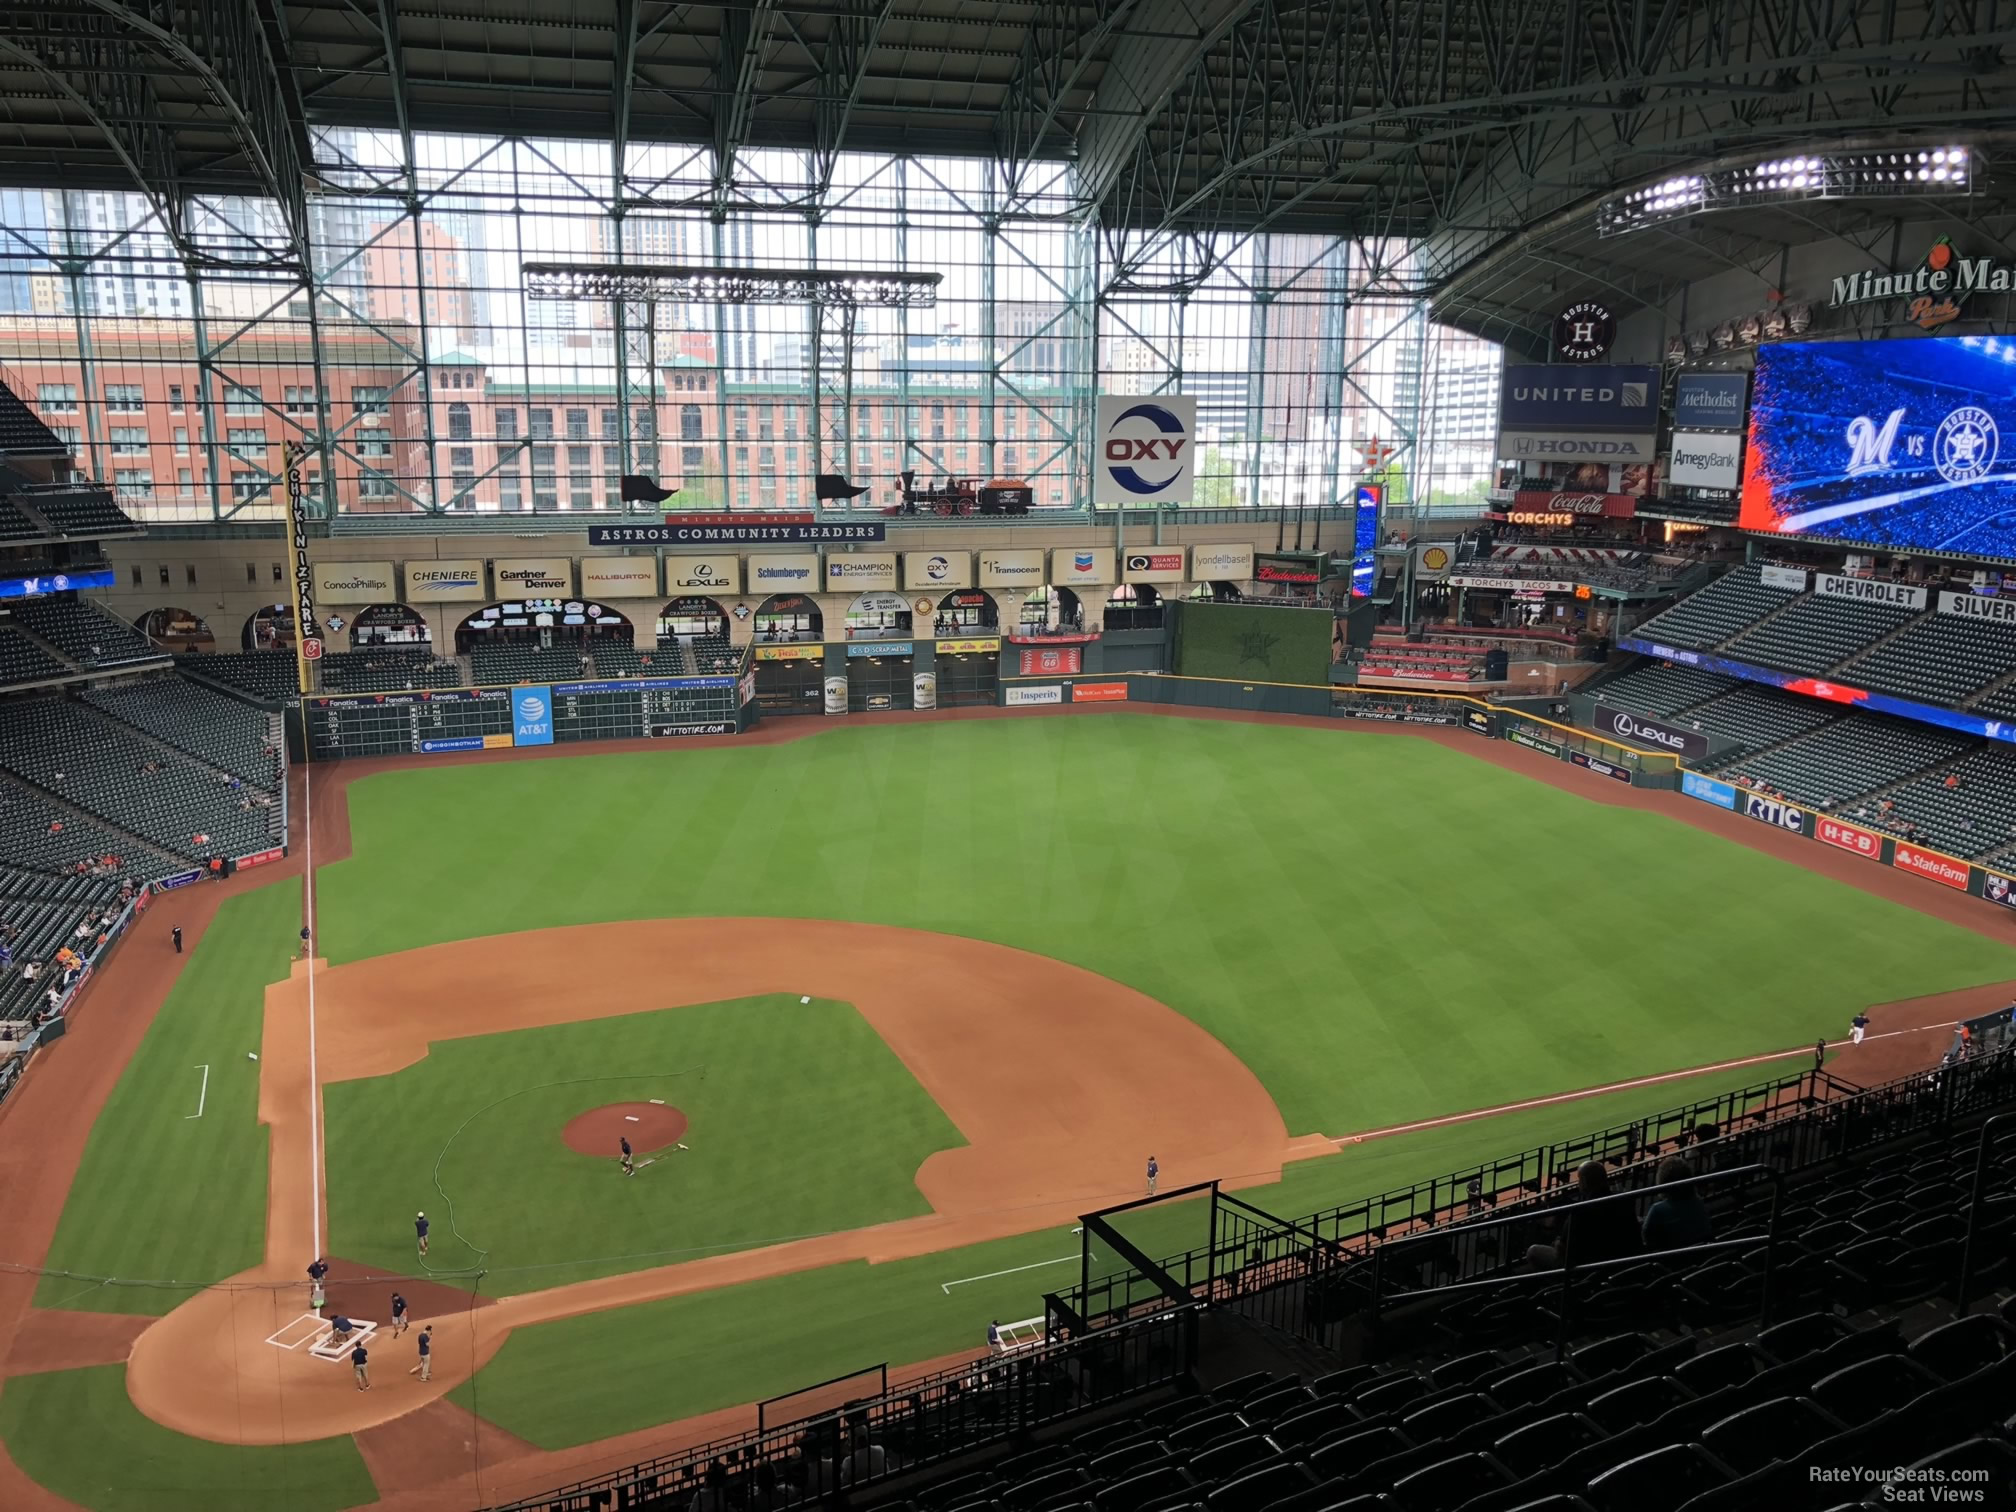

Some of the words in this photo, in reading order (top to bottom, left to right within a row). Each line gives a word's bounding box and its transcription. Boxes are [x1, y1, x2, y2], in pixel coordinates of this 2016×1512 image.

[1829, 266, 1948, 307] Minute
[1561, 303, 1609, 321] HOUSTON
[1909, 296, 1960, 322] Park
[1572, 322, 1594, 342] H
[1561, 344, 1604, 360] ASTROS
[1513, 387, 1615, 402] UNITED
[1681, 390, 1737, 408] Methodist
[1943, 410, 1994, 433] HOUSTON
[1105, 438, 1187, 461] OXY
[1537, 440, 1640, 455] HONDA
[1952, 433, 1976, 460] H
[1673, 449, 1734, 470] AmegyBank
[1940, 463, 1986, 482] ASTROS
[1548, 493, 1605, 514] Coca-Cola
[1506, 511, 1573, 526] TORCHYS
[678, 527, 791, 540] COMMUNITY
[799, 526, 875, 538] LEADERS
[843, 563, 893, 572] CHAMPION
[927, 563, 949, 571] OXY
[994, 566, 1040, 574] Transocean
[412, 570, 478, 581] CHENIERE
[500, 570, 546, 579] Gardner
[587, 573, 651, 581] HALLIBURTON
[757, 567, 810, 580] Schlumberger
[1256, 566, 1320, 582] Budweiser
[323, 579, 387, 590] ConocoPhillips
[525, 579, 566, 588] Denver
[677, 578, 730, 587] LEXUS
[1470, 578, 1515, 588] TORCHYS
[1520, 580, 1552, 589] TACOS
[1824, 576, 1917, 605] CHEVROLET
[1043, 658, 1056, 667] 66
[1391, 668, 1435, 679] Budweiser
[385, 695, 414, 704] Fanatics
[431, 693, 459, 701] Fanatics
[479, 690, 507, 698] Fanatics
[1020, 690, 1058, 700] Insperity
[329, 699, 358, 707] Fanatics
[1355, 711, 1397, 720] NITTOTIRE.COM
[1403, 716, 1447, 725] NITTOTIRE.COM
[518, 723, 548, 735] AT&T
[662, 724, 725, 736] NITTOTIRE.COM
[1518, 734, 1535, 747] National
[1633, 724, 1685, 750] LEXUS
[432, 740, 481, 749] HIGGINBOTHAM
[1626, 751, 1638, 760] 373
[1747, 794, 1800, 830] RTIC
[1987, 874, 2010, 887] MLB
